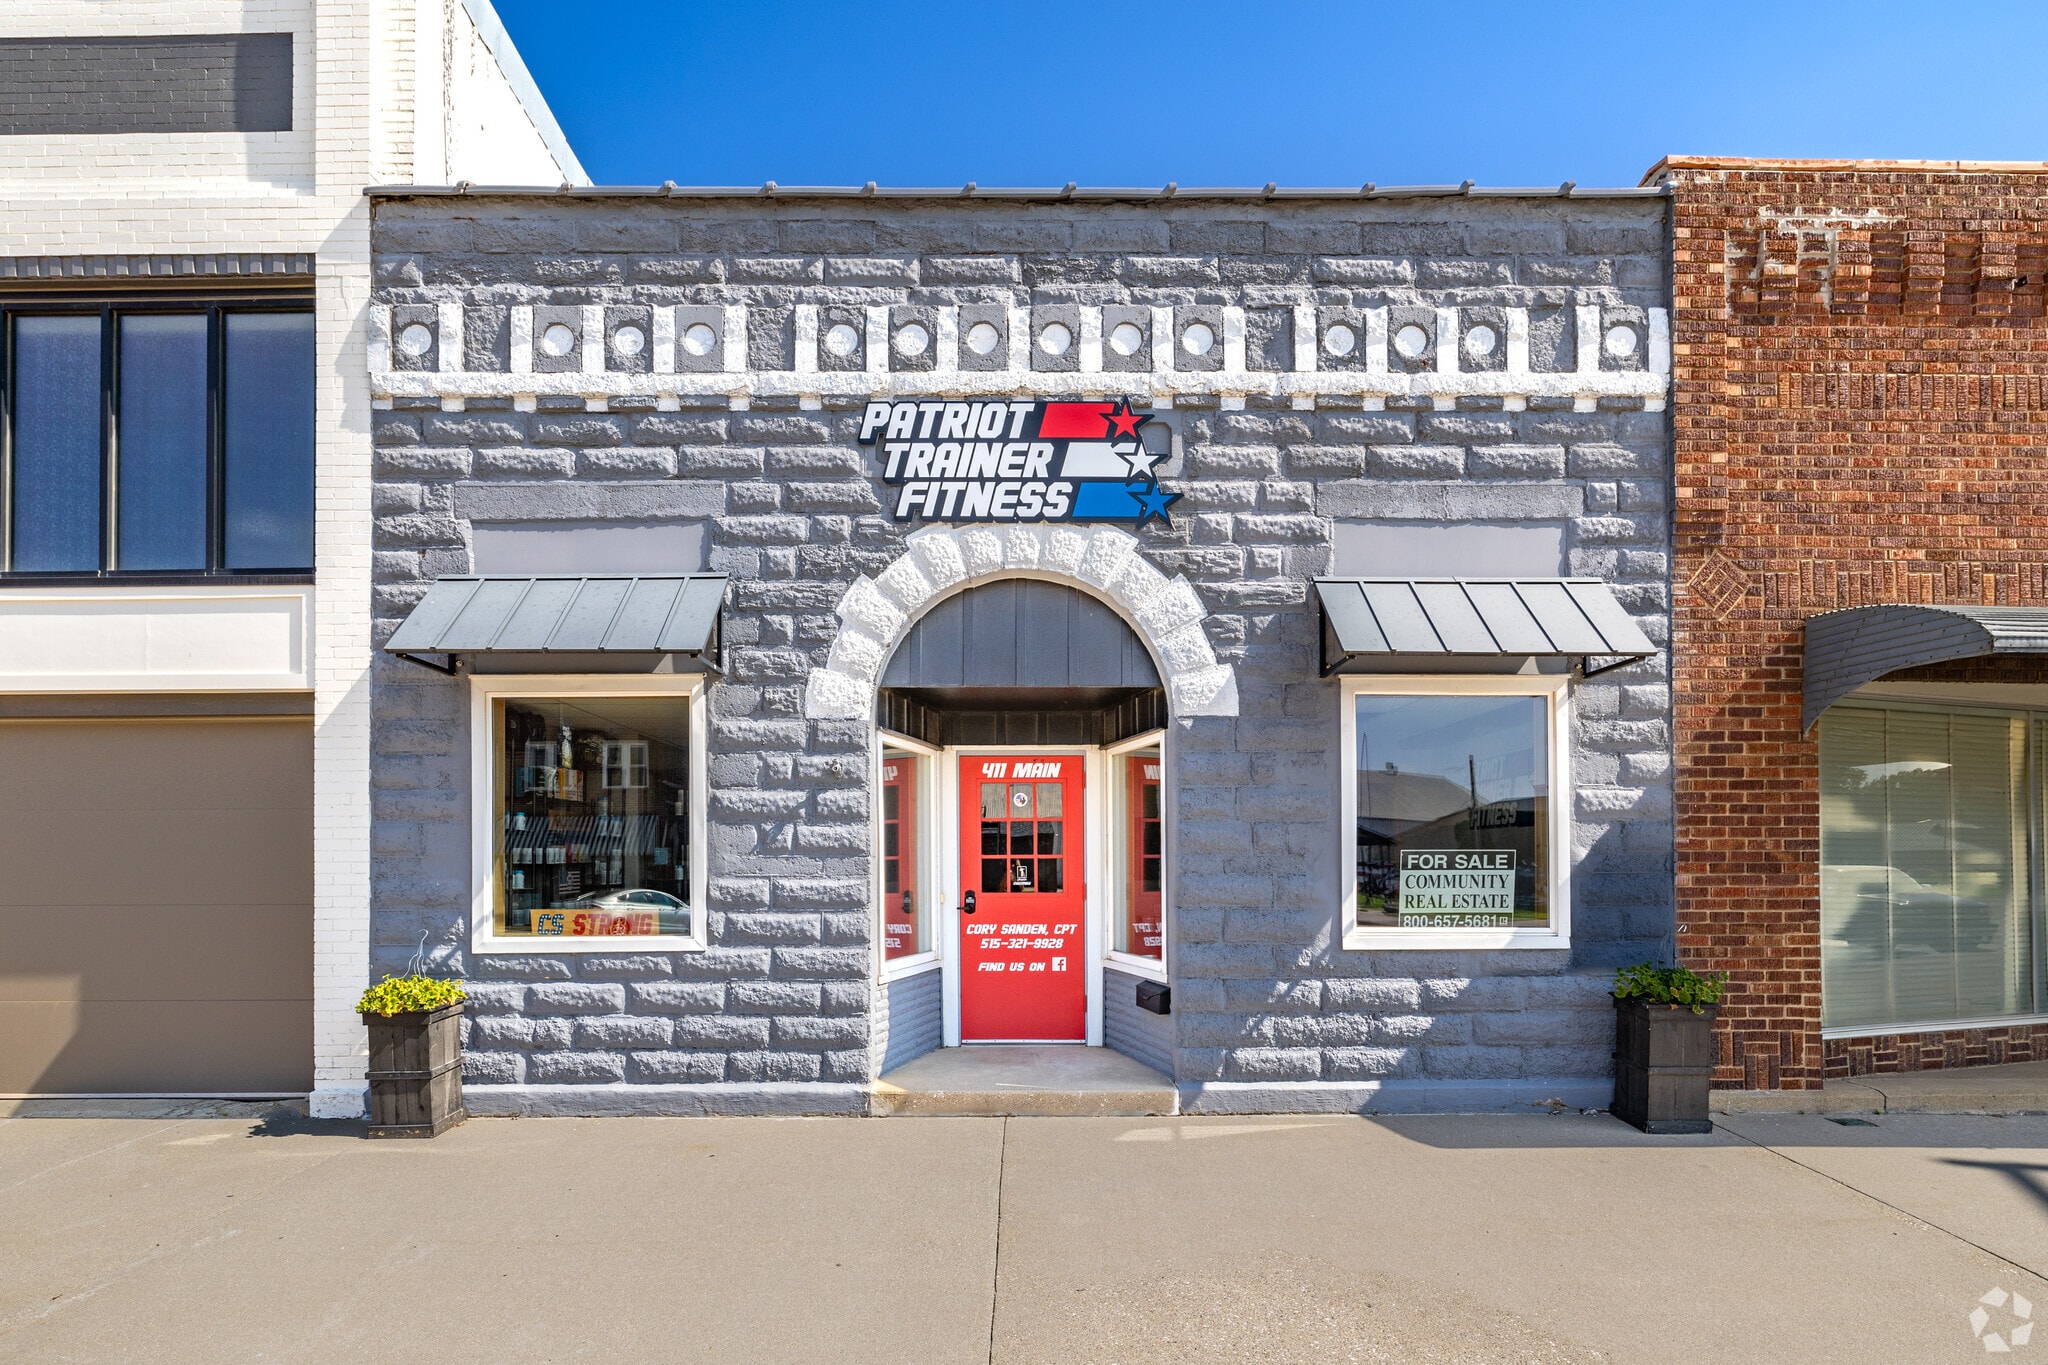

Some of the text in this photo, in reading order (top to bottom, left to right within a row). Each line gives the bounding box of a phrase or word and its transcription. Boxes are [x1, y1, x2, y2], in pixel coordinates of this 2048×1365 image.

[860, 402, 1035, 439] PATRIOT
[884, 442, 1055, 478] TRAINER
[896, 481, 1073, 517] FITNESS
[981, 762, 1062, 778] 411 MAIN
[1407, 854, 1508, 869] FOR SALE
[1405, 874, 1510, 889] COMMUNITY
[1405, 894, 1510, 909] REAL ESTATE
[538, 914, 564, 935] CS
[1403, 914, 1497, 927] 800-657-5681
[966, 924, 1078, 936] CORY SANDEN, CPT
[980, 938, 1064, 949] 515-321-9928
[978, 962, 1006, 972] FIND
[1009, 962, 1026, 972] US
[1029, 962, 1046, 972] ON
